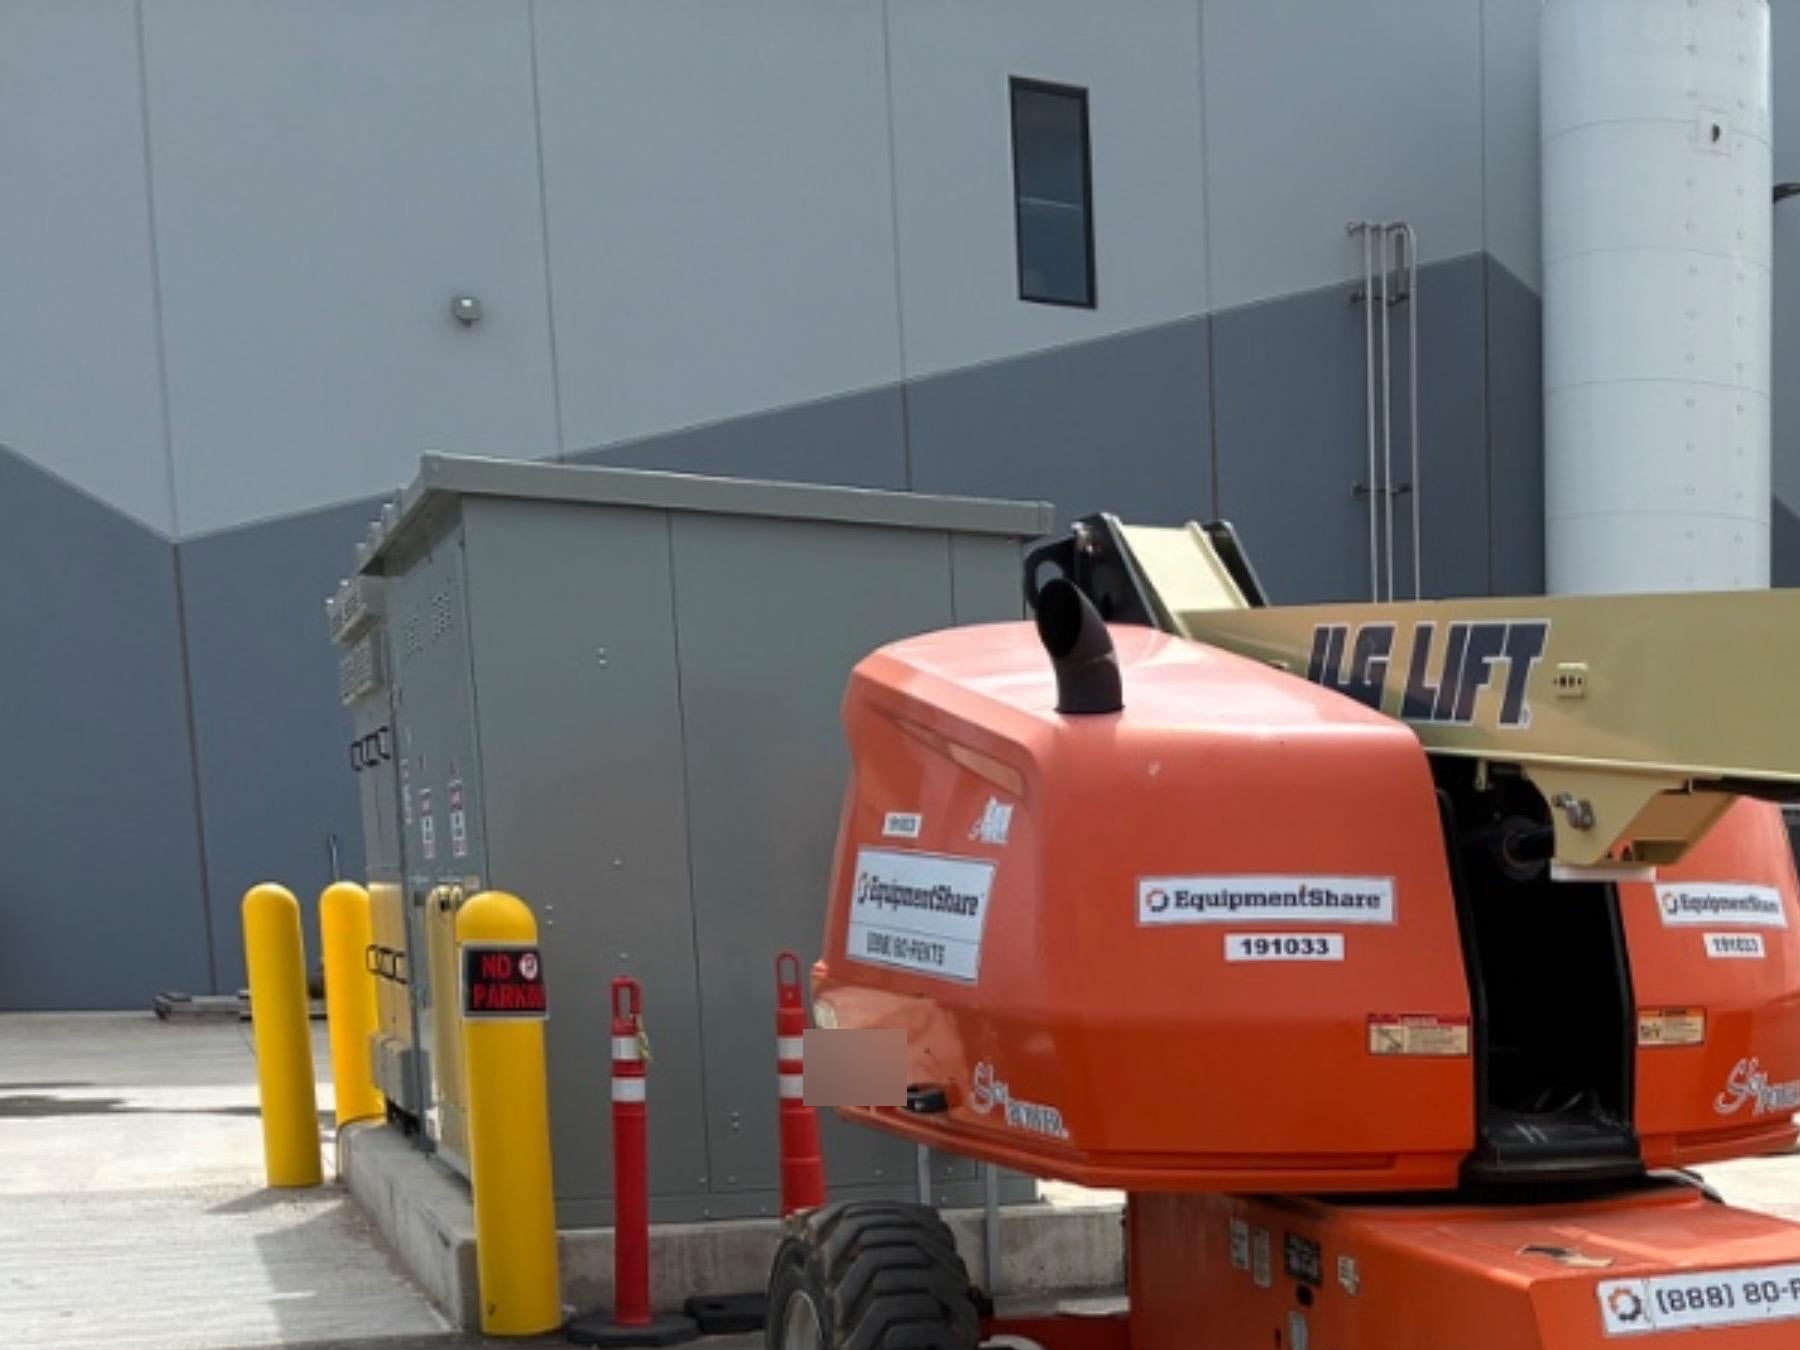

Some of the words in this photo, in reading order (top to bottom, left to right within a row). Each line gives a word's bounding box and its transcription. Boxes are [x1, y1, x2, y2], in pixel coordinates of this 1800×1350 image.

[1401, 615, 1550, 728] LIFT
[1174, 885, 1382, 911] EquipmentShare
[1240, 937, 1329, 955] 191033
[482, 953, 511, 979] NO
[1655, 1283, 1735, 1315] (888)
